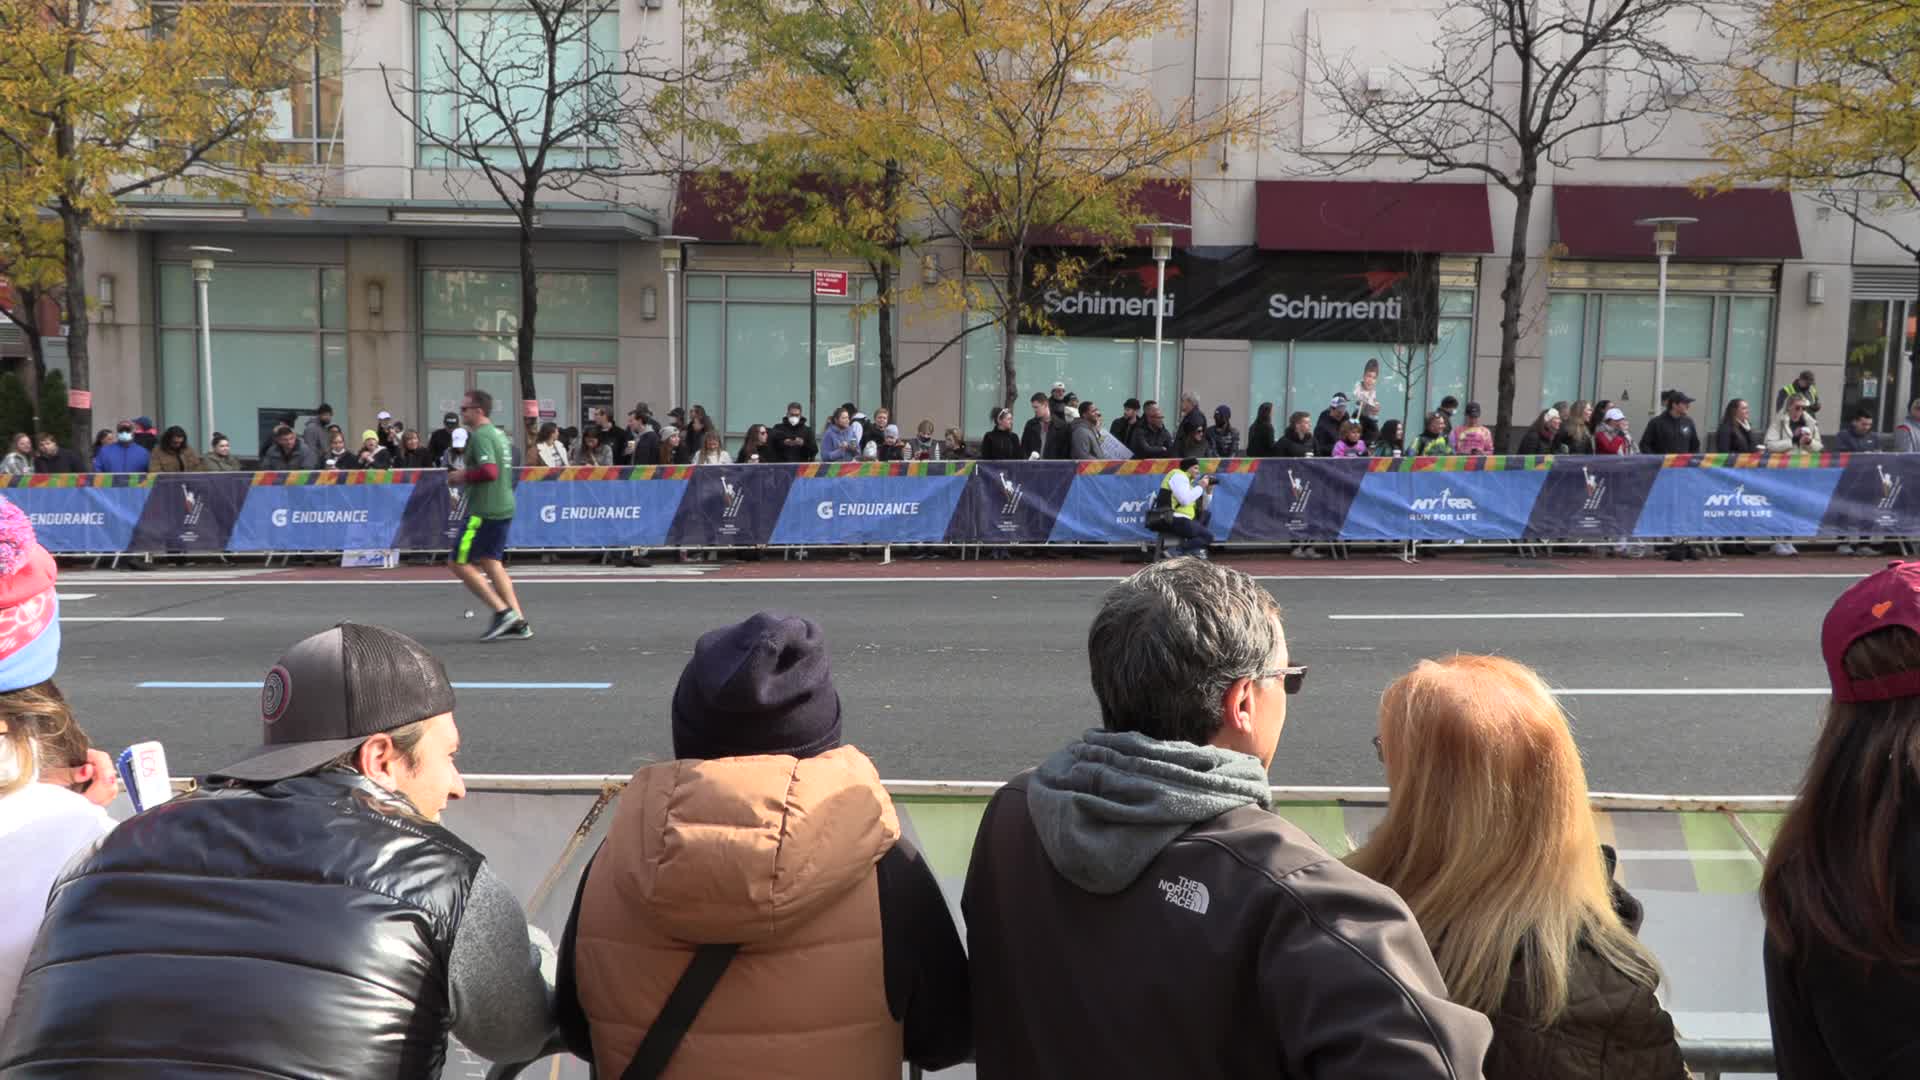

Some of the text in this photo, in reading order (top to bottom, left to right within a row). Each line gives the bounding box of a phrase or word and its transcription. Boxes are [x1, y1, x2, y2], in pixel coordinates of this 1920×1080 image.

[1268, 293, 1402, 319] Schimenti
[561, 506, 641, 520] ENDURANCE
[838, 502, 920, 516] ENDURANCE
[1703, 510, 1773, 518] RUN FOR LIFE
[31, 512, 104, 525] ENDURANCE
[292, 510, 369, 523] ENDURANCE
[1158, 879, 1194, 901] NORTH
[1178, 875, 1199, 891] THE
[1165, 892, 1192, 909] FACE
